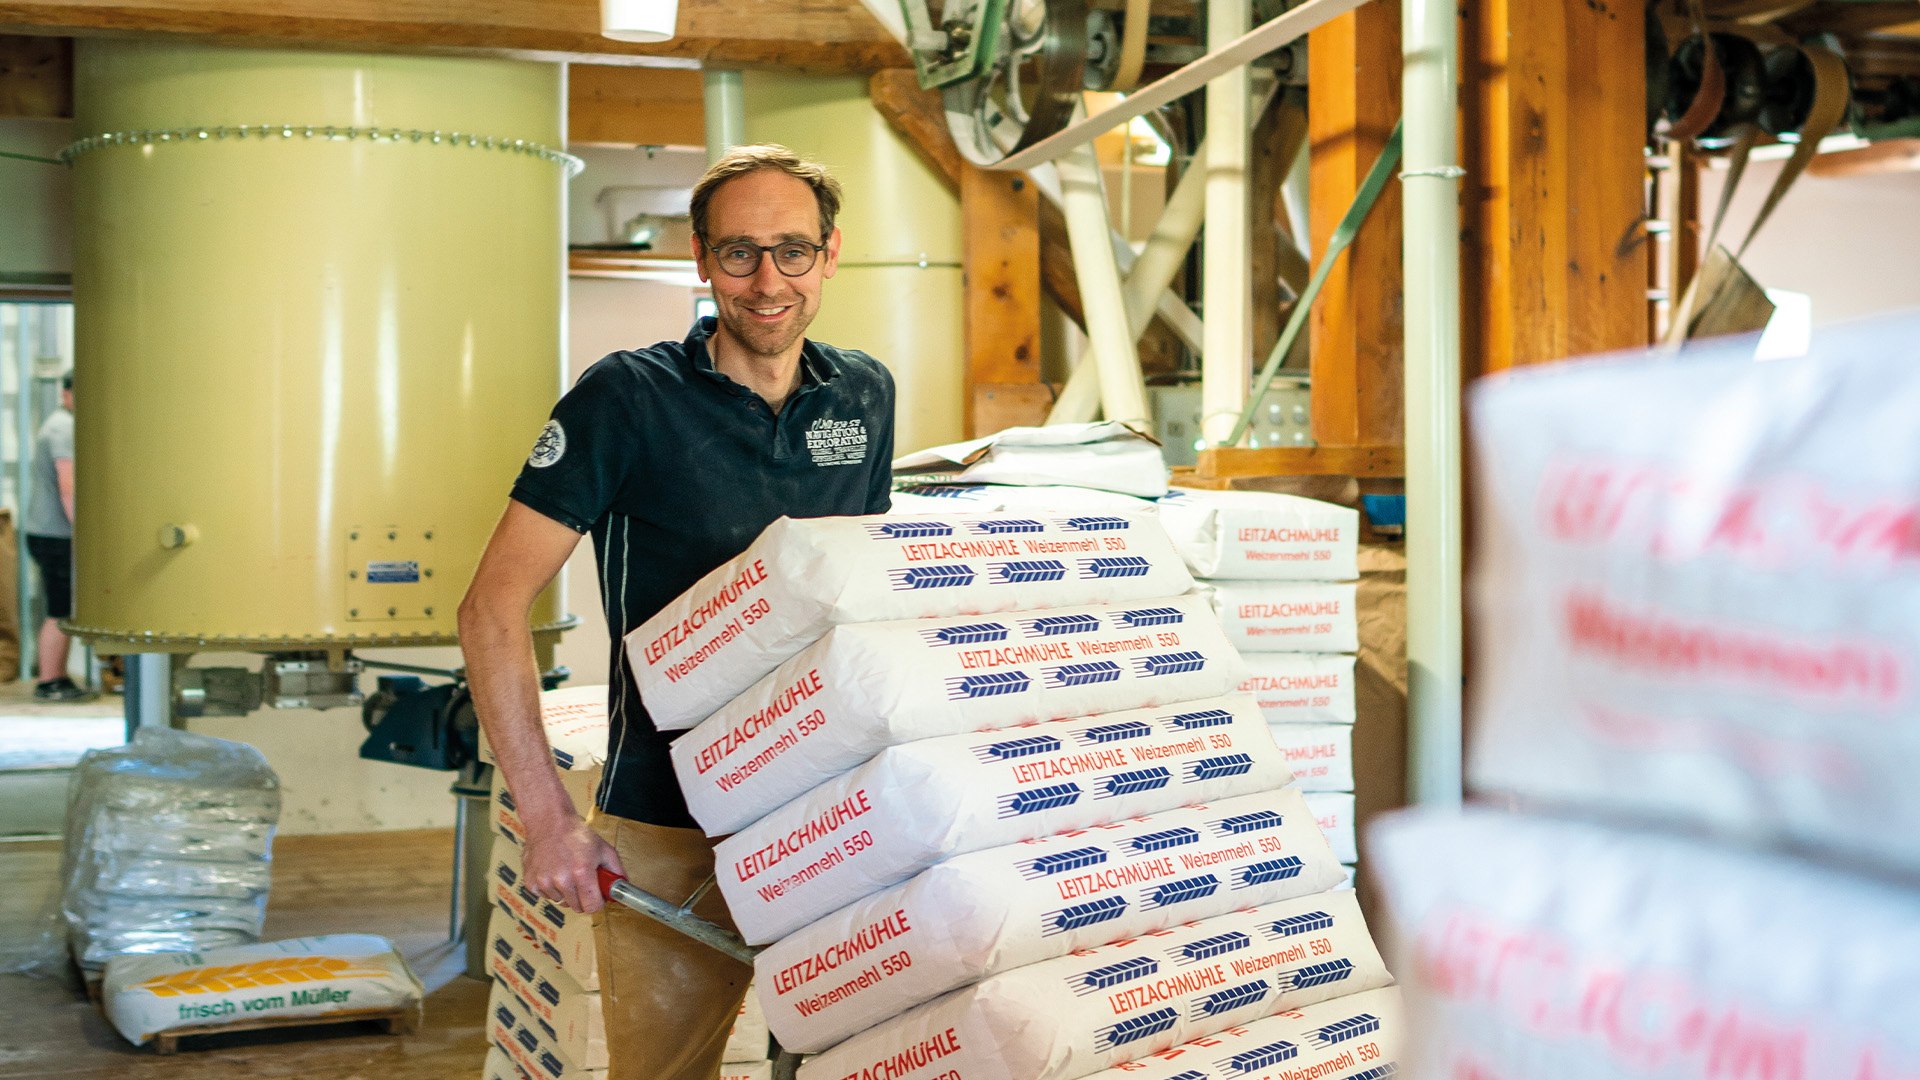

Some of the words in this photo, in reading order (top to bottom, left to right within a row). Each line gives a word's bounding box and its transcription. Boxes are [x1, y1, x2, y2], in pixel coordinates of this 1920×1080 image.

[805, 428, 859, 440] NAVIGATION
[807, 434, 868, 449] EXPLORATION
[900, 539, 1020, 562] LEITZACHMÜHLE
[1023, 538, 1100, 554] Weizenmehl
[1103, 537, 1128, 551] 550
[1238, 528, 1340, 542] LEITZACHMÜHLE
[1313, 551, 1332, 561] 550
[643, 559, 768, 666] LEITZACHMÜHLE
[1238, 601, 1340, 619] LEITZACHMÜHLE
[1313, 624, 1332, 634] 550
[664, 617, 745, 683] Weizenmehl
[742, 597, 771, 625] 550
[957, 641, 1074, 669] LEITZACHMÜHLE
[1076, 634, 1153, 656] Weizenmehl
[1156, 632, 1180, 648] 550
[693, 668, 824, 775] LEITZACHMÜHLE
[715, 728, 799, 793] Weizenmehl
[796, 708, 826, 737] 550
[1011, 748, 1128, 784] LEITZACHMÜHLE
[1131, 737, 1207, 762] Weizenmehl
[1211, 733, 1232, 749] 550
[734, 789, 872, 883] LEITZACHMÜHLE
[757, 846, 844, 903] Weizenmehl
[843, 829, 874, 857] 550
[1056, 856, 1176, 900] LEITZACHMÜHLE
[1179, 840, 1256, 871] Weizenmehl
[1259, 836, 1282, 854] 550
[773, 909, 912, 996] LEITZACHMÜHLE
[1108, 964, 1226, 1015] LEITZACHMÜHLE
[1230, 944, 1307, 978] Weizenmehl
[1310, 937, 1332, 957] 550
[178, 999, 236, 1019] frisch
[242, 995, 285, 1012] vom
[290, 987, 351, 1007] Müller
[794, 965, 882, 1018] Weizenmehl
[880, 949, 912, 977] 550
[1357, 1042, 1381, 1062] 550
